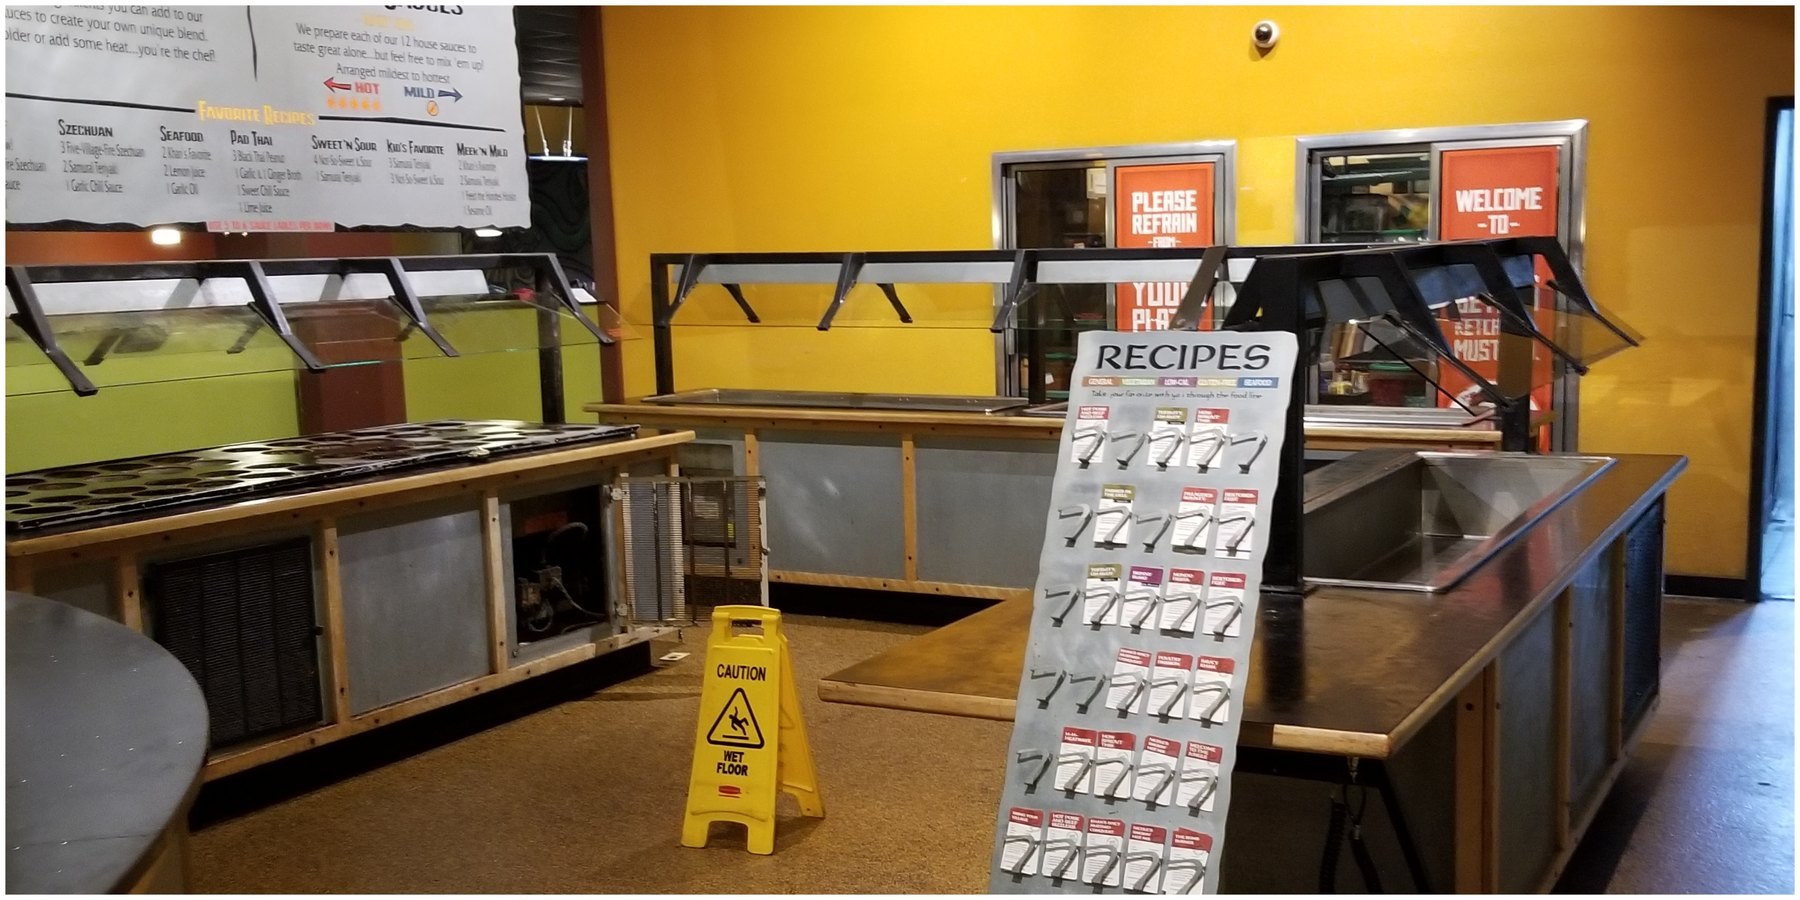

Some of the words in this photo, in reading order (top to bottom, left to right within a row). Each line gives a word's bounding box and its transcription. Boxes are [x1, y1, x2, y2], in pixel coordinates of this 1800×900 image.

[5, 8, 32, 21] uces
[35, 12, 46, 23] to
[50, 14, 84, 27] create
[87, 19, 110, 31] your
[114, 21, 136, 33] own
[140, 25, 174, 39] unique
[108, 5, 127, 14] you
[131, 5, 148, 15] can
[152, 6, 170, 18] add
[174, 9, 184, 20] to
[187, 11, 203, 22] our
[34, 33, 45, 44] or
[50, 34, 70, 47] add
[73, 37, 103, 50] some
[174, 47, 189, 59] the
[296, 22, 312, 36] We
[314, 27, 349, 41] prepare
[351, 31, 371, 43] each
[373, 32, 382, 43] of
[384, 36, 398, 46] our
[414, 36, 438, 50] house
[440, 42, 466, 53] sauces
[468, 44, 477, 54] to
[293, 42, 315, 53] taste
[318, 45, 341, 57] great
[391, 50, 405, 63] feel
[408, 52, 424, 65] free
[426, 56, 435, 66] to
[437, 56, 452, 67] mix
[336, 63, 376, 80] Arranged
[379, 68, 409, 81] mildest
[411, 72, 420, 81] to
[422, 71, 450, 84] hottest
[354, 82, 380, 95] HOT
[404, 86, 435, 99] MILD
[198, 99, 260, 122] FAVORITE
[263, 104, 316, 126] RECIPES
[58, 118, 113, 137] SZECHUAN
[160, 125, 204, 142] SEAFOOD
[354, 137, 377, 152] SOUR
[408, 140, 445, 155] FAVORITE
[63, 160, 68, 172] 2
[1131, 189, 1198, 213] PLEASE
[1455, 186, 1544, 212] WELCOME
[1131, 213, 1197, 235] REFRAIN
[1132, 308, 1178, 332] PLA
[1455, 318, 1500, 336] KETCH
[1096, 344, 1271, 370] RECIPES
[1454, 339, 1499, 361] MUST
[717, 663, 767, 681] CAUTION
[723, 750, 745, 763] WET
[716, 762, 748, 776] FLOOR
